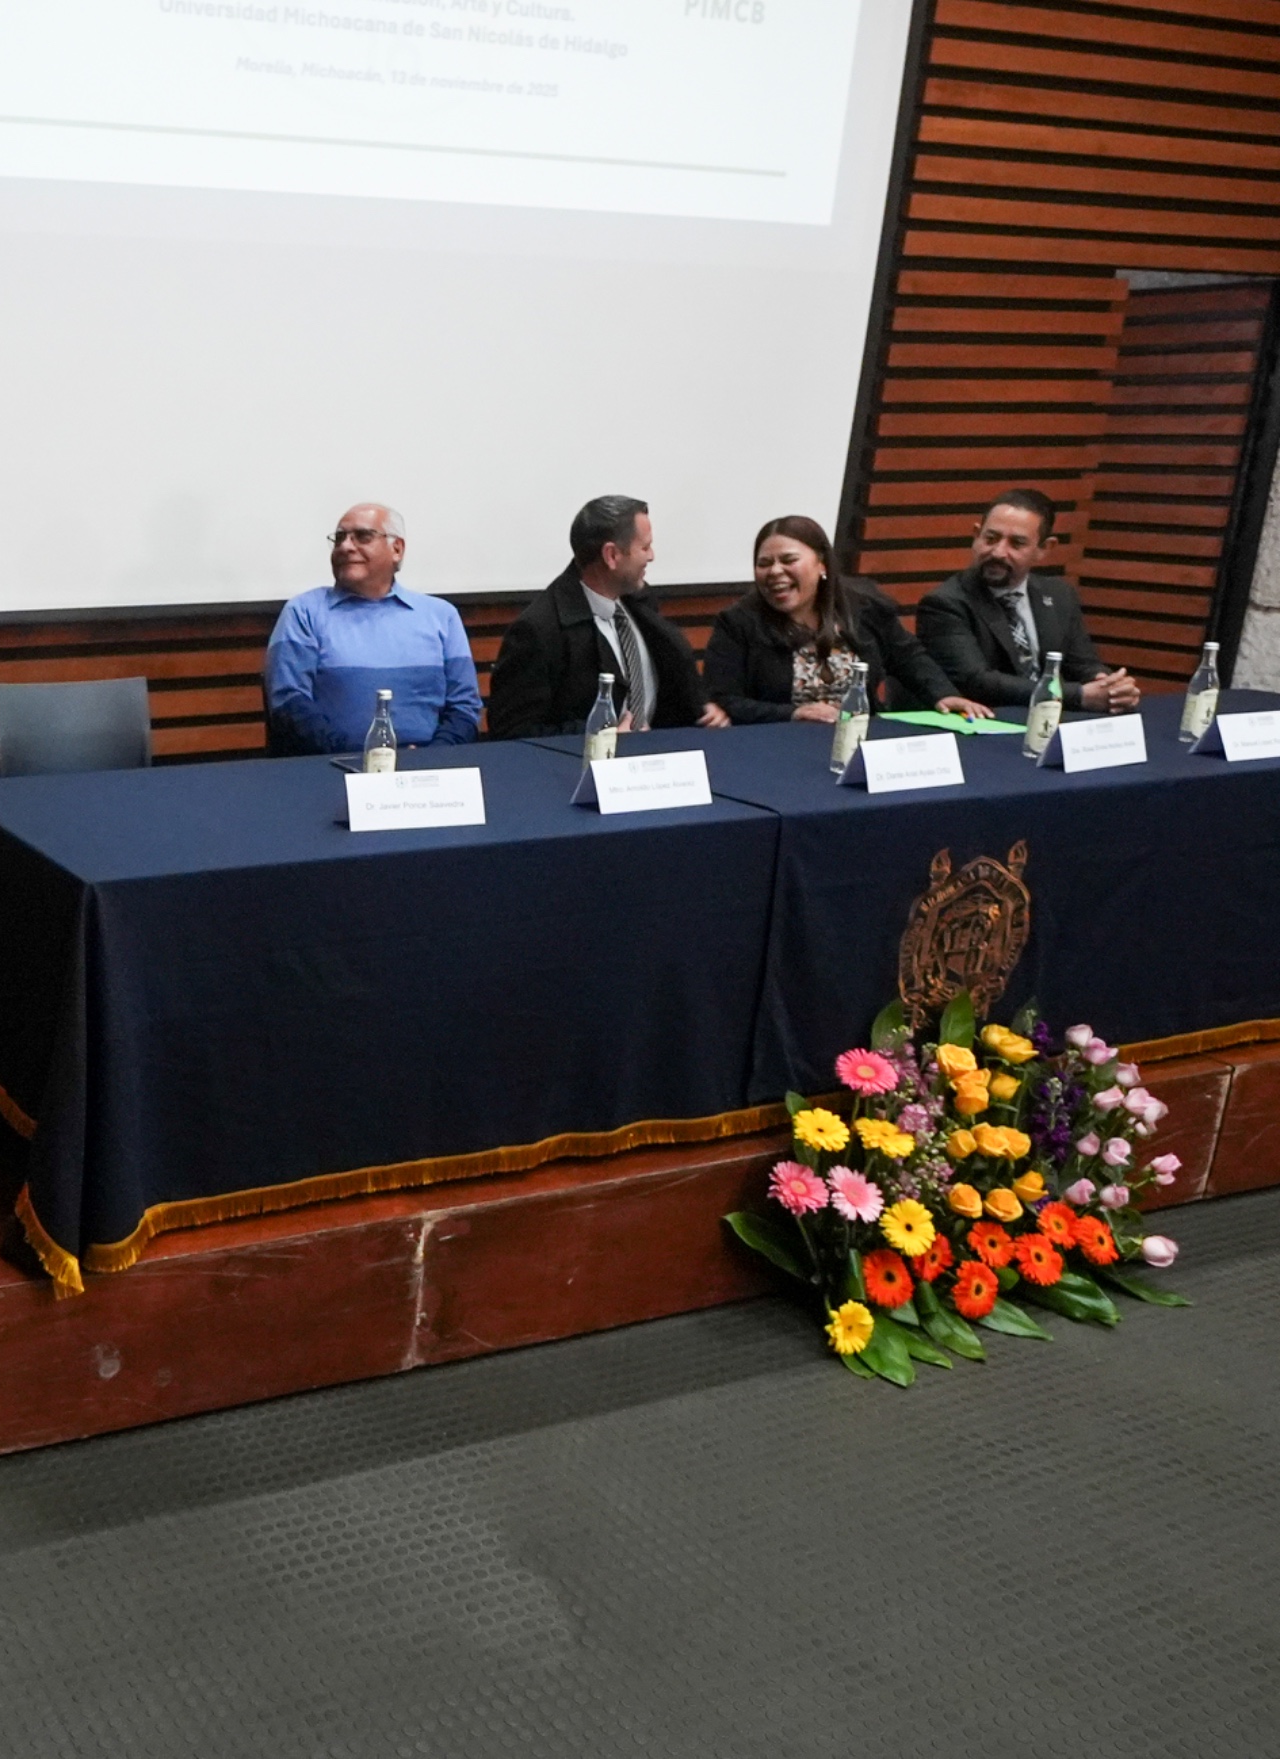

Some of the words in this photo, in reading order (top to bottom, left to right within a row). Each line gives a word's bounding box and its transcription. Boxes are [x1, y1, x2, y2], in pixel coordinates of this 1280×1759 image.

[491, 1, 502, 18] y
[506, 0, 575, 22] Cultura.
[684, 0, 765, 24] PIMCB
[160, 0, 277, 23] Universidad
[283, 6, 397, 35] Michoacana
[403, 19, 424, 37] de
[429, 21, 462, 41] San
[467, 25, 534, 48] Nicolás
[539, 33, 560, 50] de
[564, 37, 628, 60] Hidalgo
[235, 56, 296, 78] Morelia,
[300, 61, 384, 85] Michoacán,
[391, 69, 407, 84] 13
[409, 72, 426, 86] de
[429, 75, 503, 94] noviembre
[506, 81, 523, 95] de
[526, 82, 559, 98] 2025
